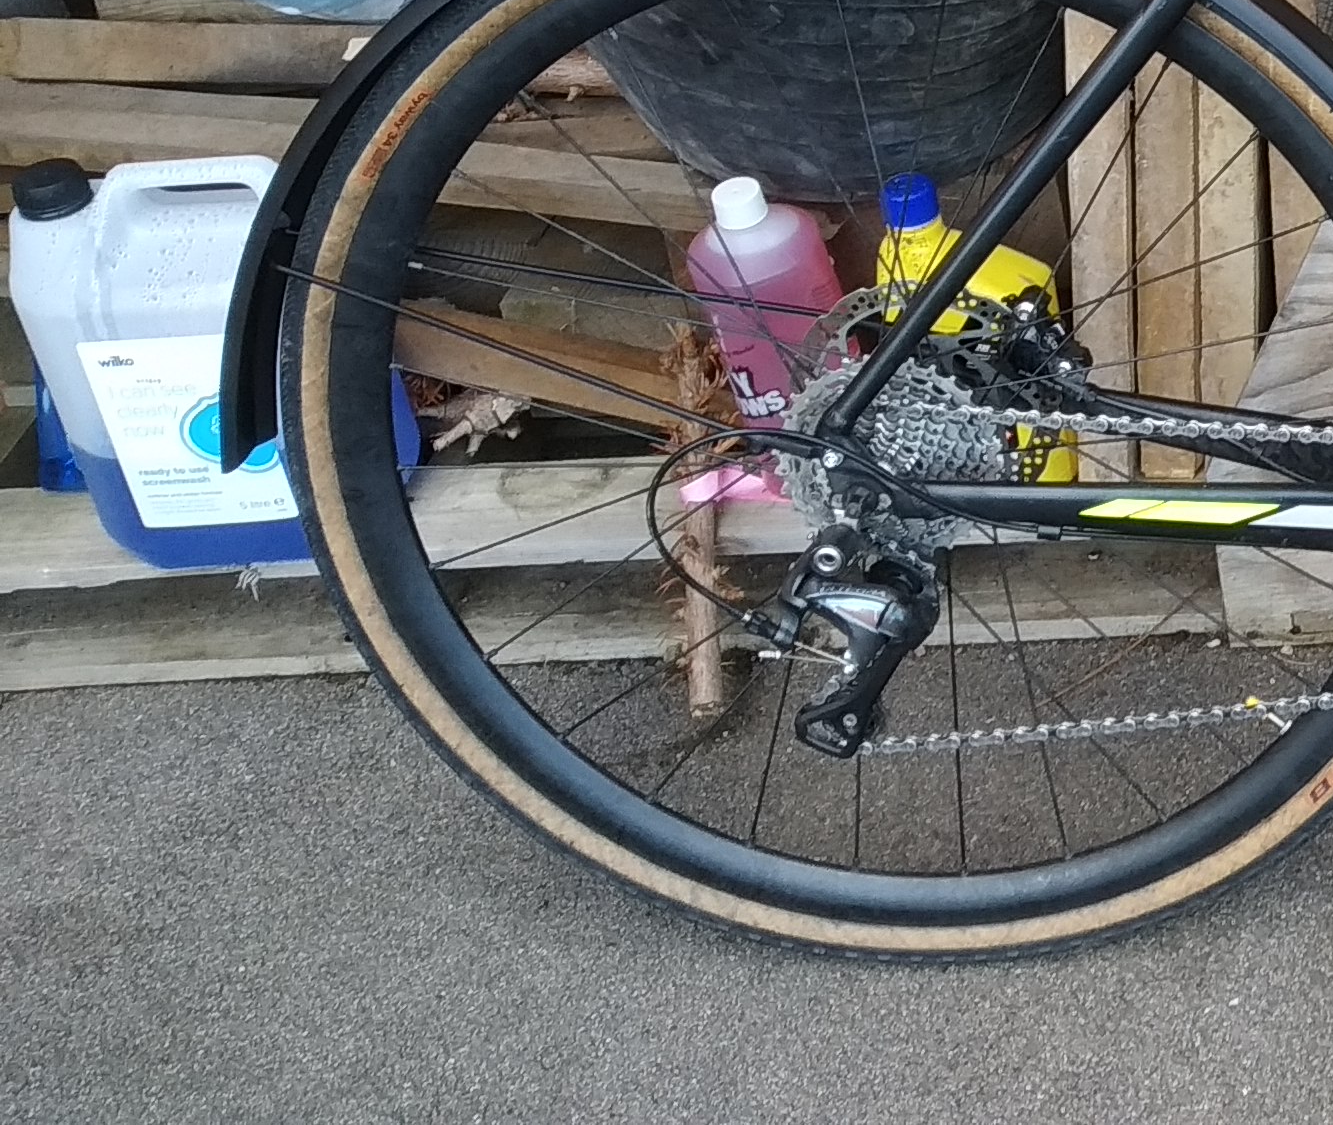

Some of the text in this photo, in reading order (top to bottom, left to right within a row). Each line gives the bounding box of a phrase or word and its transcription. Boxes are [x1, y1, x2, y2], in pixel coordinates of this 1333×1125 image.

[382, 92, 428, 146] byway 34
[98, 356, 135, 367] wilko
[119, 386, 155, 399] can
[160, 383, 197, 396] see
[117, 403, 179, 420] clearly
[123, 426, 165, 438] now
[138, 465, 210, 478] ready to use
[142, 476, 212, 486] screenwash
[239, 500, 248, 510] 5
